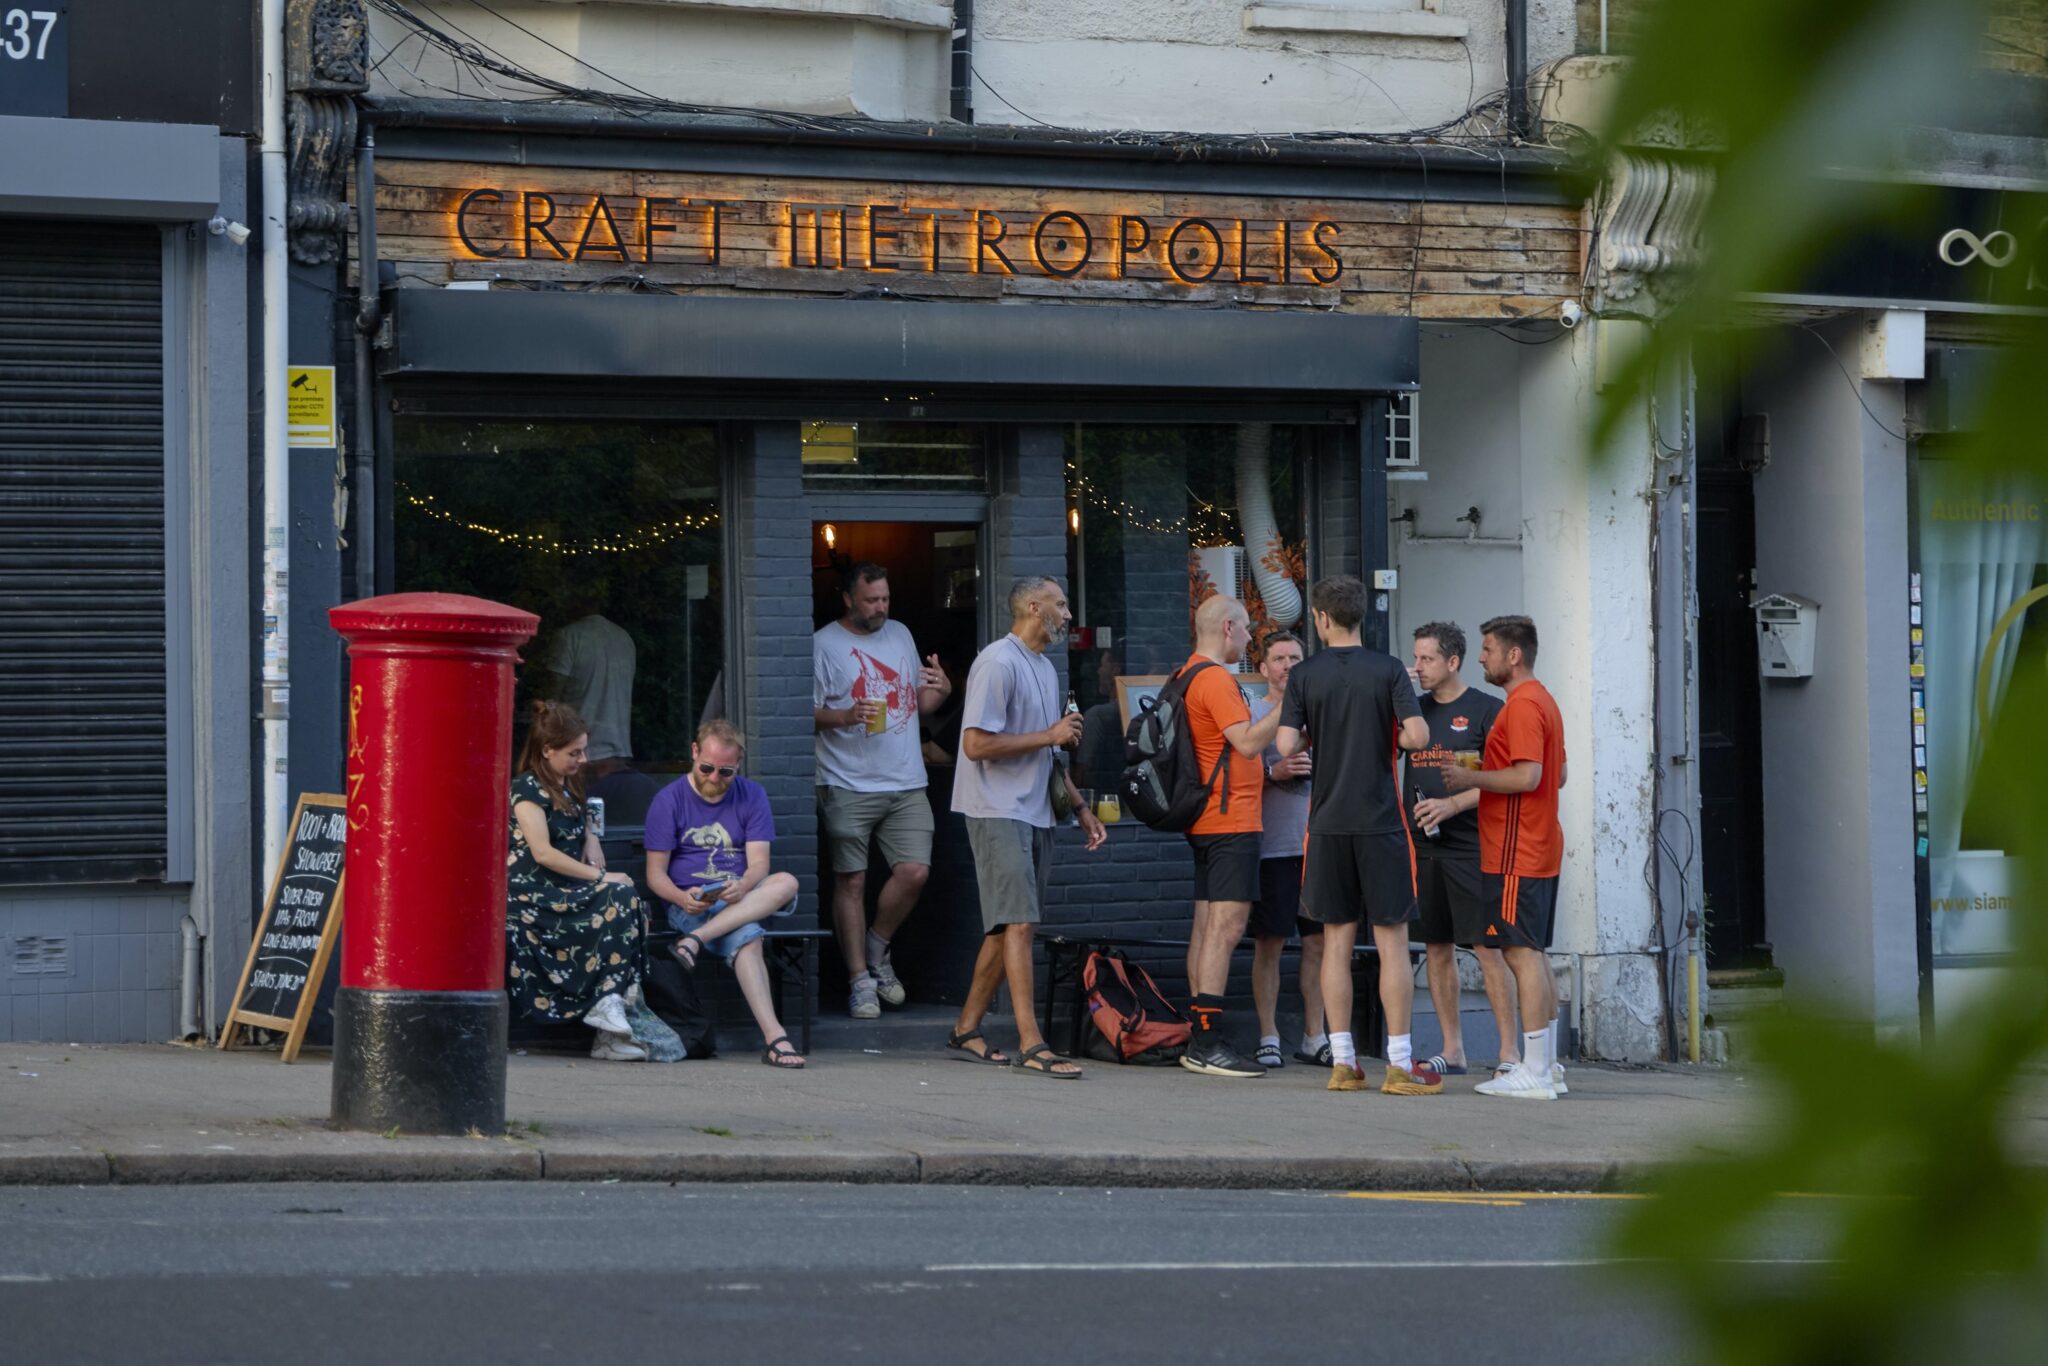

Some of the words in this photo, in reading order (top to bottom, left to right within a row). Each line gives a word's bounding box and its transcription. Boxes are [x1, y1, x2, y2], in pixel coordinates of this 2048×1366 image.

[0, 9, 57, 60] 37
[456, 188, 740, 266] CRAFT
[790, 203, 1344, 284] METROPOLIS
[296, 811, 325, 842] ROOT
[326, 813, 347, 843] BRAN
[295, 847, 341, 874] SHOWCASE!
[280, 885, 303, 905] SUPER
[302, 888, 324, 907] FRESH
[292, 908, 319, 927] FROM
[262, 932, 281, 949] LONG
[250, 969, 276, 989] STARTS
